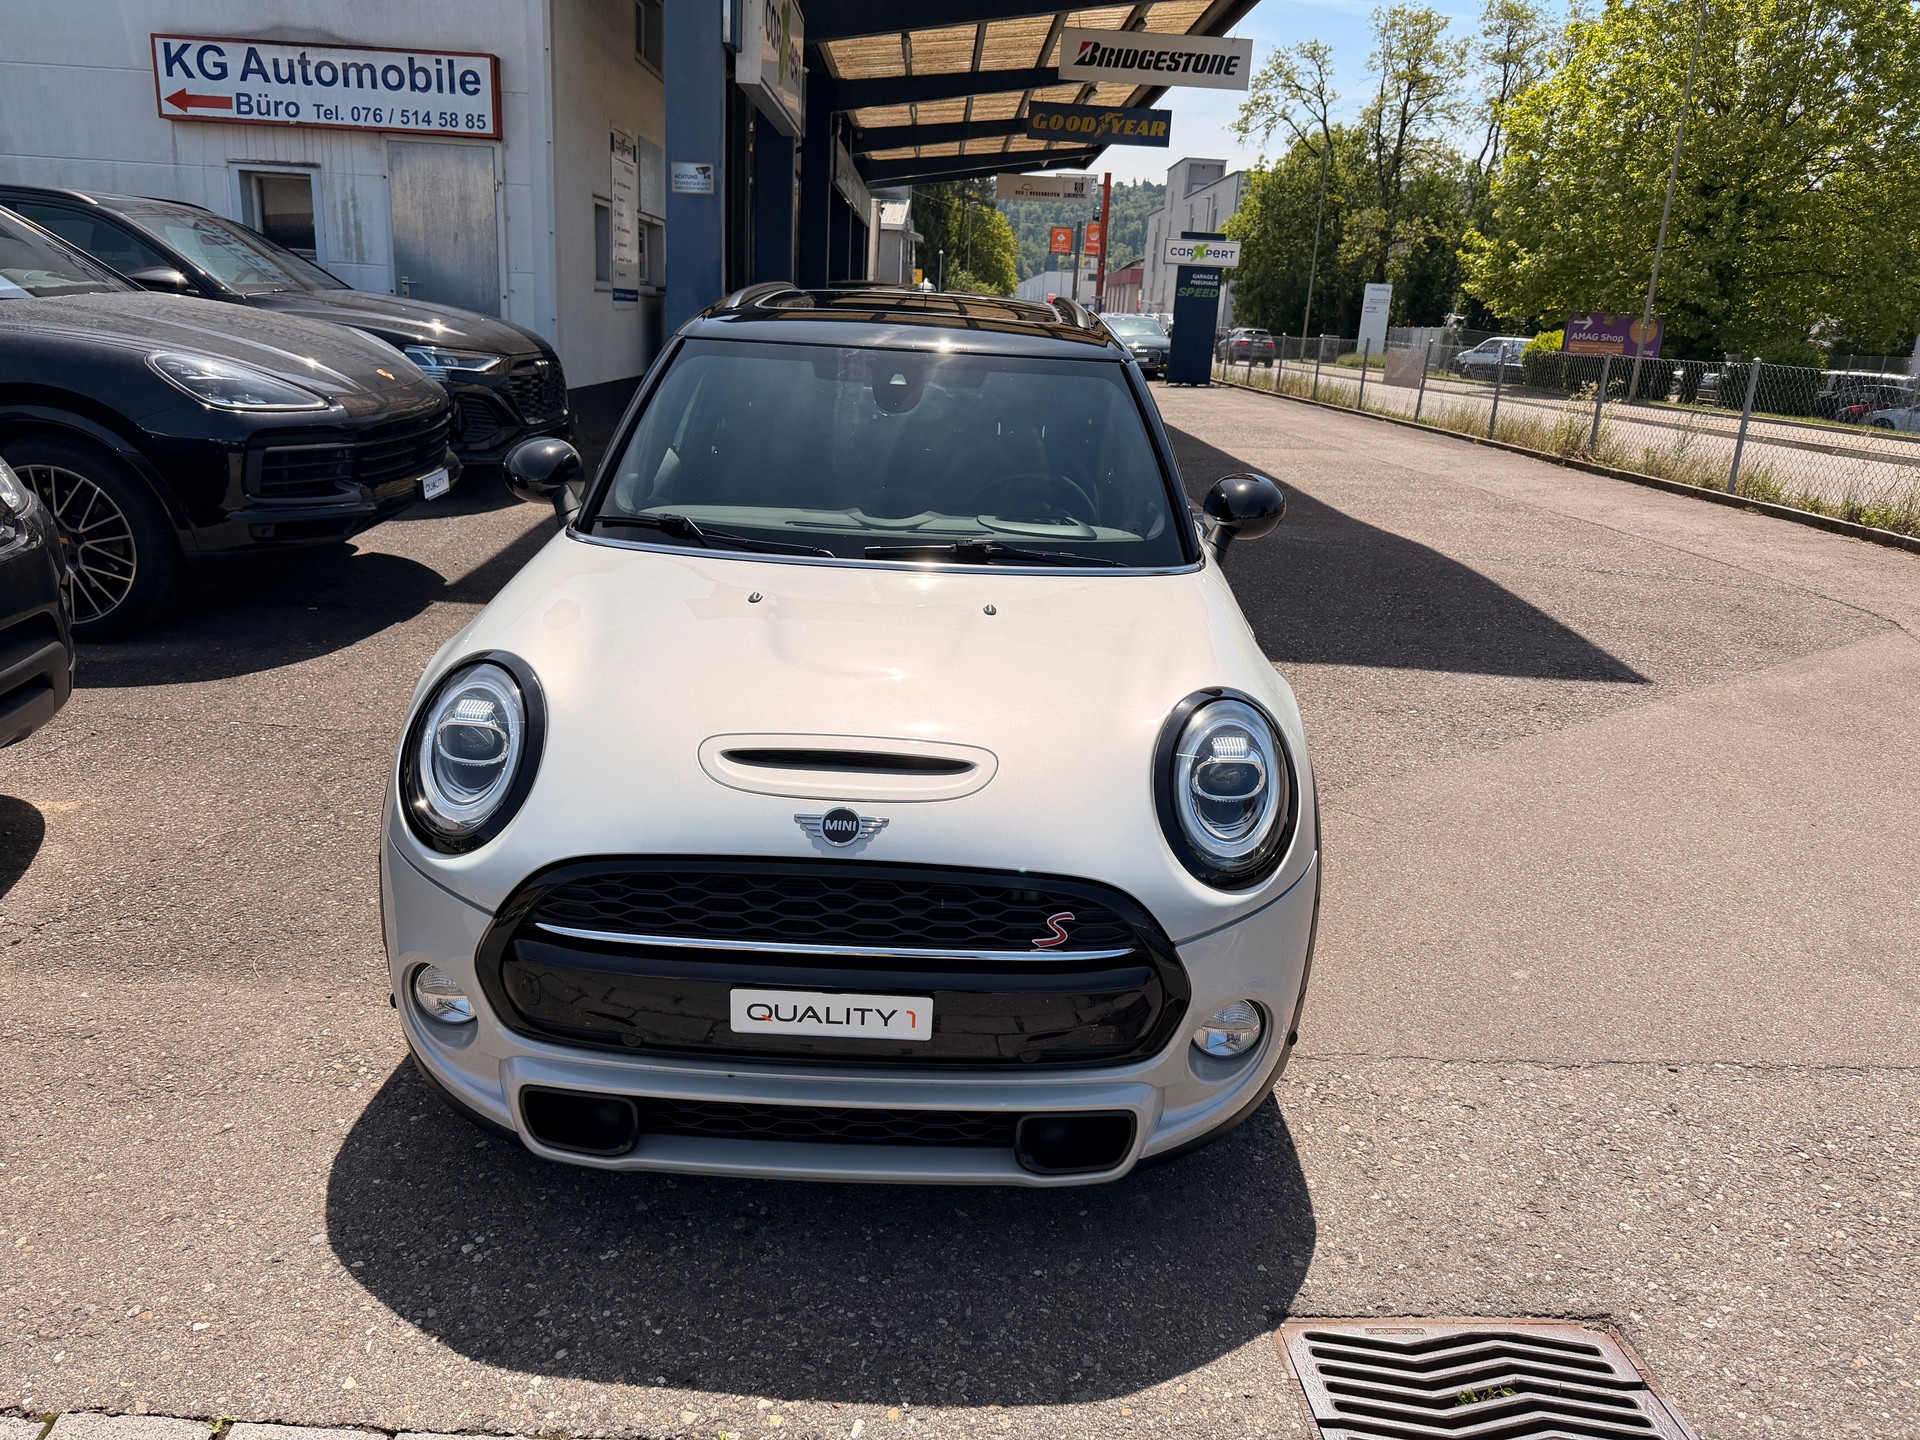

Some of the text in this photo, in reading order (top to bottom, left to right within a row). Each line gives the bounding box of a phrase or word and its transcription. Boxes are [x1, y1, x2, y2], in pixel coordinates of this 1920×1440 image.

[163, 42, 482, 97] KG Automobile
[1073, 41, 1241, 76] BRIDGESTONE
[235, 92, 487, 130] Büro Tel. 076 / 514 58 85
[1192, 273, 1214, 281] GARAGE
[1177, 287, 1220, 299] SPEED
[1570, 332, 1624, 344] AMAG Shop
[825, 819, 857, 832] MINI
[1031, 911, 1076, 948] S
[746, 1003, 917, 1028] QUALITY 1
